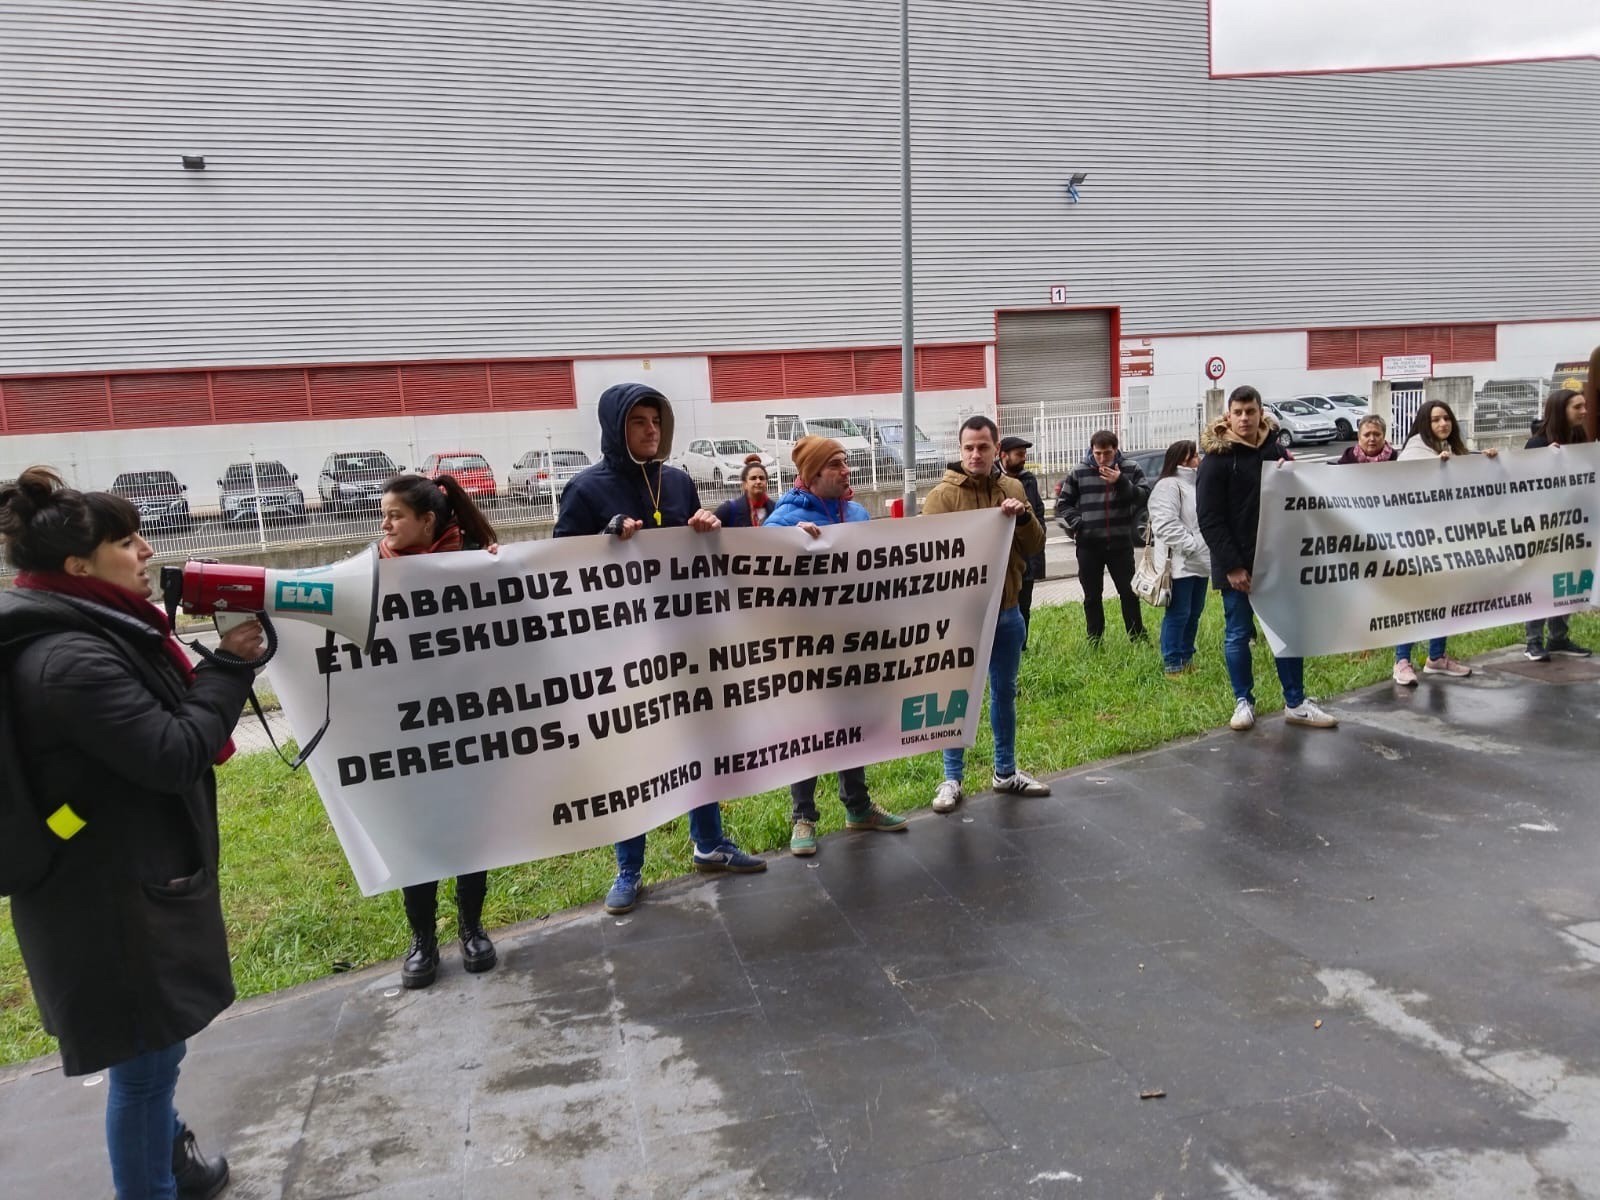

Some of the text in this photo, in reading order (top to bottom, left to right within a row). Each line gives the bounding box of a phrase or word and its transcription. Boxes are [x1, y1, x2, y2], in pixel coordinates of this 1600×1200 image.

[1055, 289, 1061, 301] 1
[1212, 364, 1222, 372] 20
[1284, 471, 1596, 511] ZABALDUZ KOOP LANGILEAK ZAINDU! RATIOAK BETE
[1300, 507, 1589, 557] ZABALDUZ COOP. CUMPLE LA RATIO.
[376, 538, 965, 622] ABALDUZ KOOP LANGILEEN OSASUNA
[1300, 561, 1360, 585] CUIDA
[1364, 560, 1378, 578] A
[1553, 569, 1594, 598] ELA
[281, 585, 326, 605] ELA
[1369, 606, 1447, 632] ATERPETXEKO
[1451, 592, 1533, 618] HEZITZAILEAK
[315, 564, 988, 675] ETA ESKUBIDEAK ZUEN ERANTZUNKIZUNA!
[398, 618, 951, 731] ZABALDUZ COOP. NUESTRA SALUD Y
[337, 647, 976, 786] DERECHOS, VUESTRA RESPONSABILIDAD
[901, 689, 969, 732] ELA
[901, 733, 929, 745] EUSKAL
[552, 726, 863, 825] ATERPETXEKO HEZITZAILEAK
